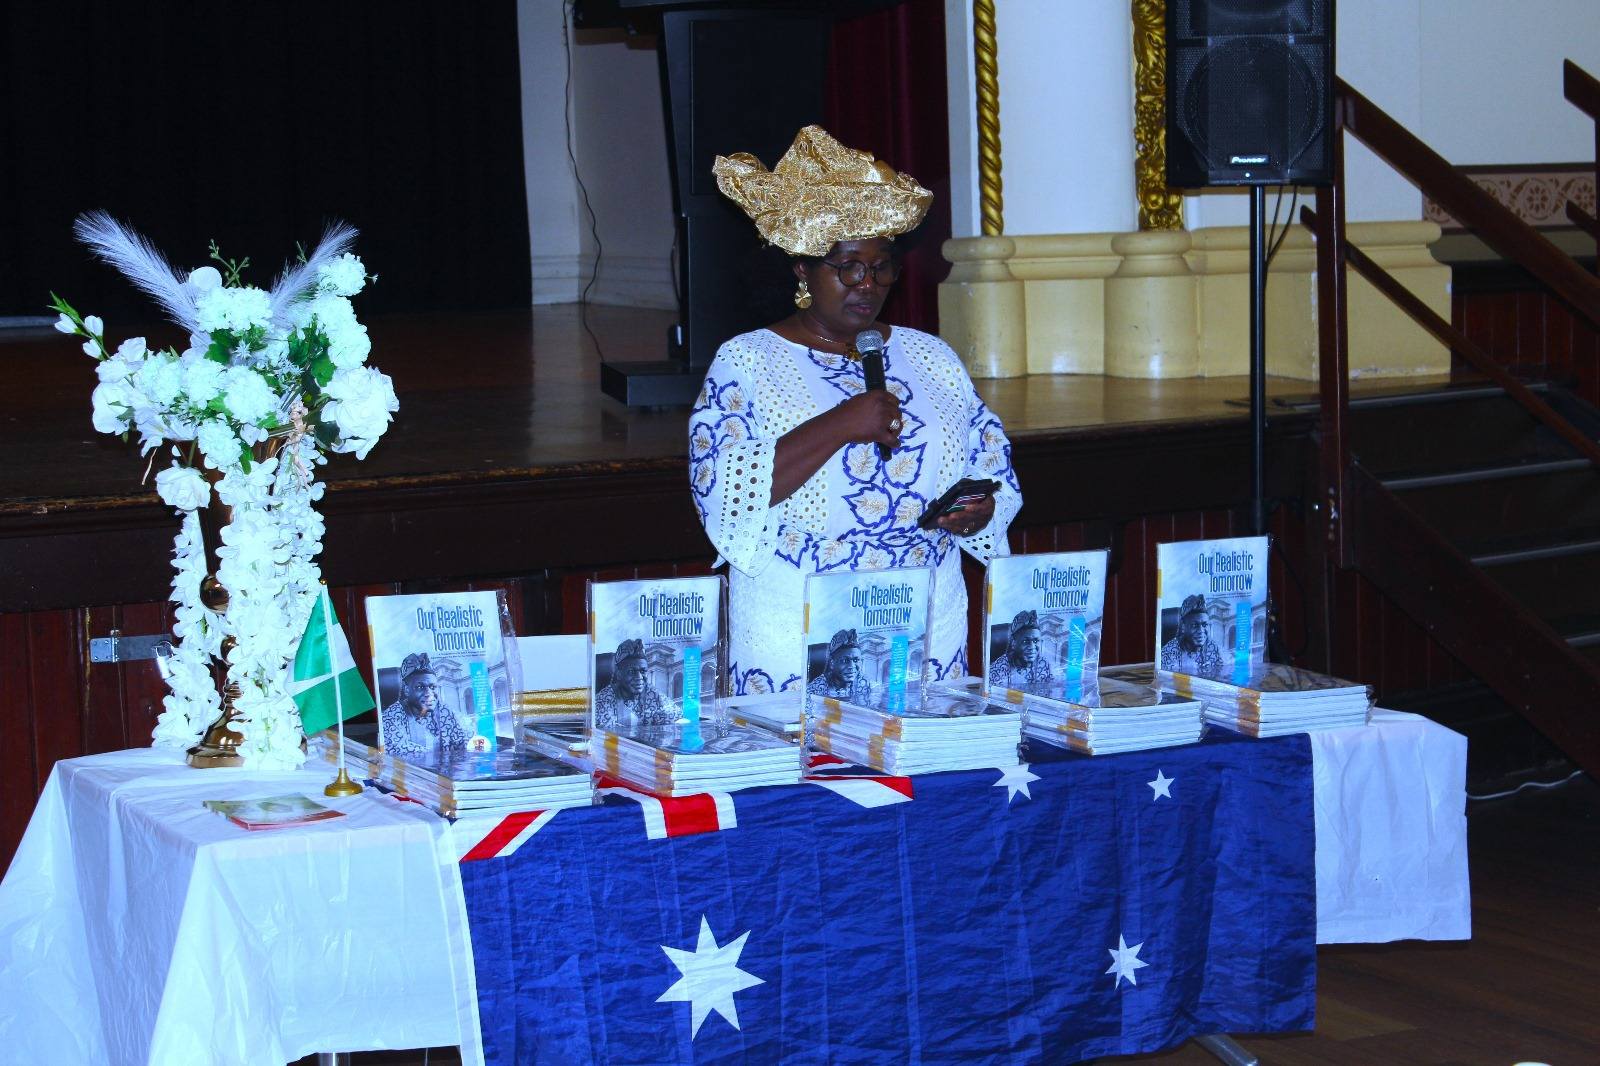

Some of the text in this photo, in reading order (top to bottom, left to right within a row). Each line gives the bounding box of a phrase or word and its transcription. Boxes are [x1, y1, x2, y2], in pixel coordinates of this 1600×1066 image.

[1231, 156, 1266, 164] Pioneer
[1198, 550, 1253, 574] Our Realistic
[1032, 565, 1091, 590] Our Realistic
[1209, 572, 1253, 593] Tomorrow
[639, 592, 704, 617] Our Realistic
[851, 582, 914, 608] Our Realistic
[1043, 587, 1090, 609] Tomorrow
[416, 604, 483, 630] Our Realistic
[651, 615, 704, 637] Tomorrow
[863, 605, 912, 627] Tomorrow
[431, 628, 485, 652] Tomorrow
